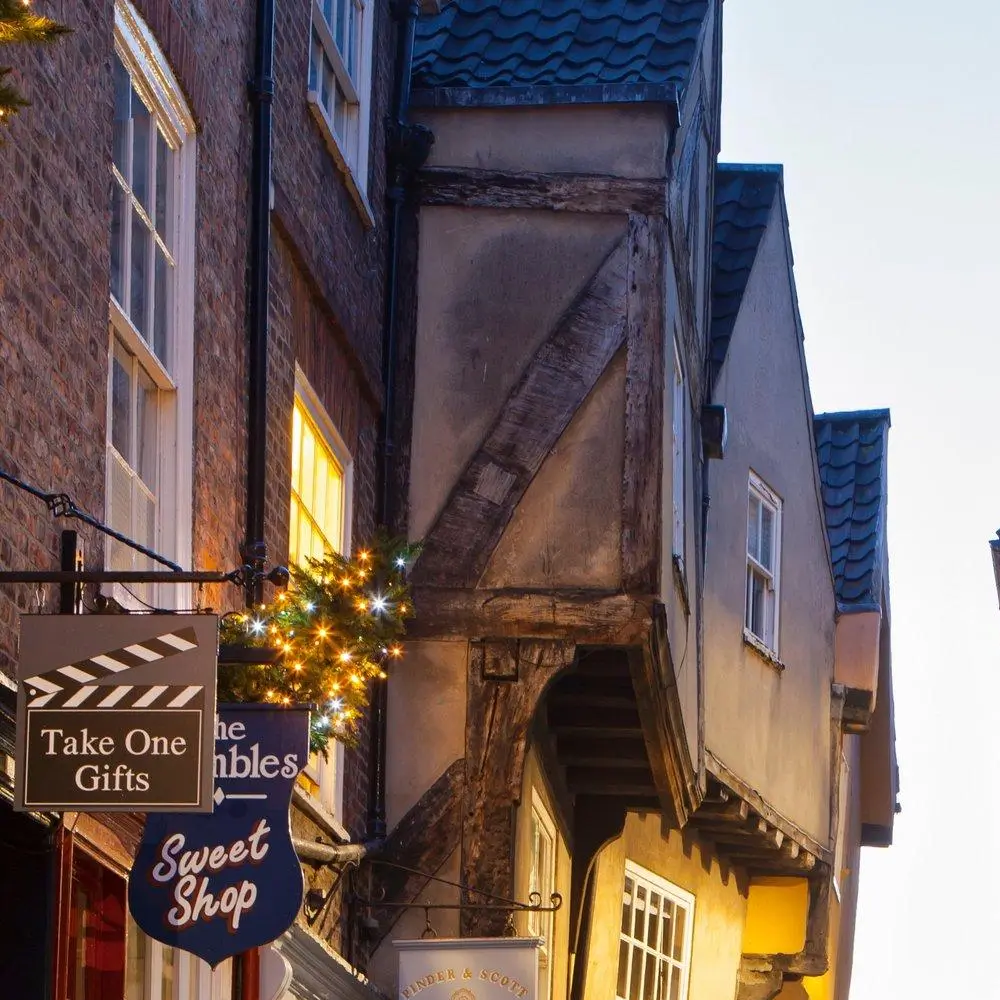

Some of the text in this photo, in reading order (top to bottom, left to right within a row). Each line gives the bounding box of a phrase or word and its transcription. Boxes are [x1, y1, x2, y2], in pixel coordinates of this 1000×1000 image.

[41, 729, 187, 756] Take One
[216, 718, 246, 741] he
[214, 744, 298, 779] mbles
[75, 765, 150, 792] Gifts
[152, 818, 271, 883] Sweet
[167, 875, 258, 930] Shop
[462, 967, 473, 980] &
[479, 969, 529, 999] SCOTT
